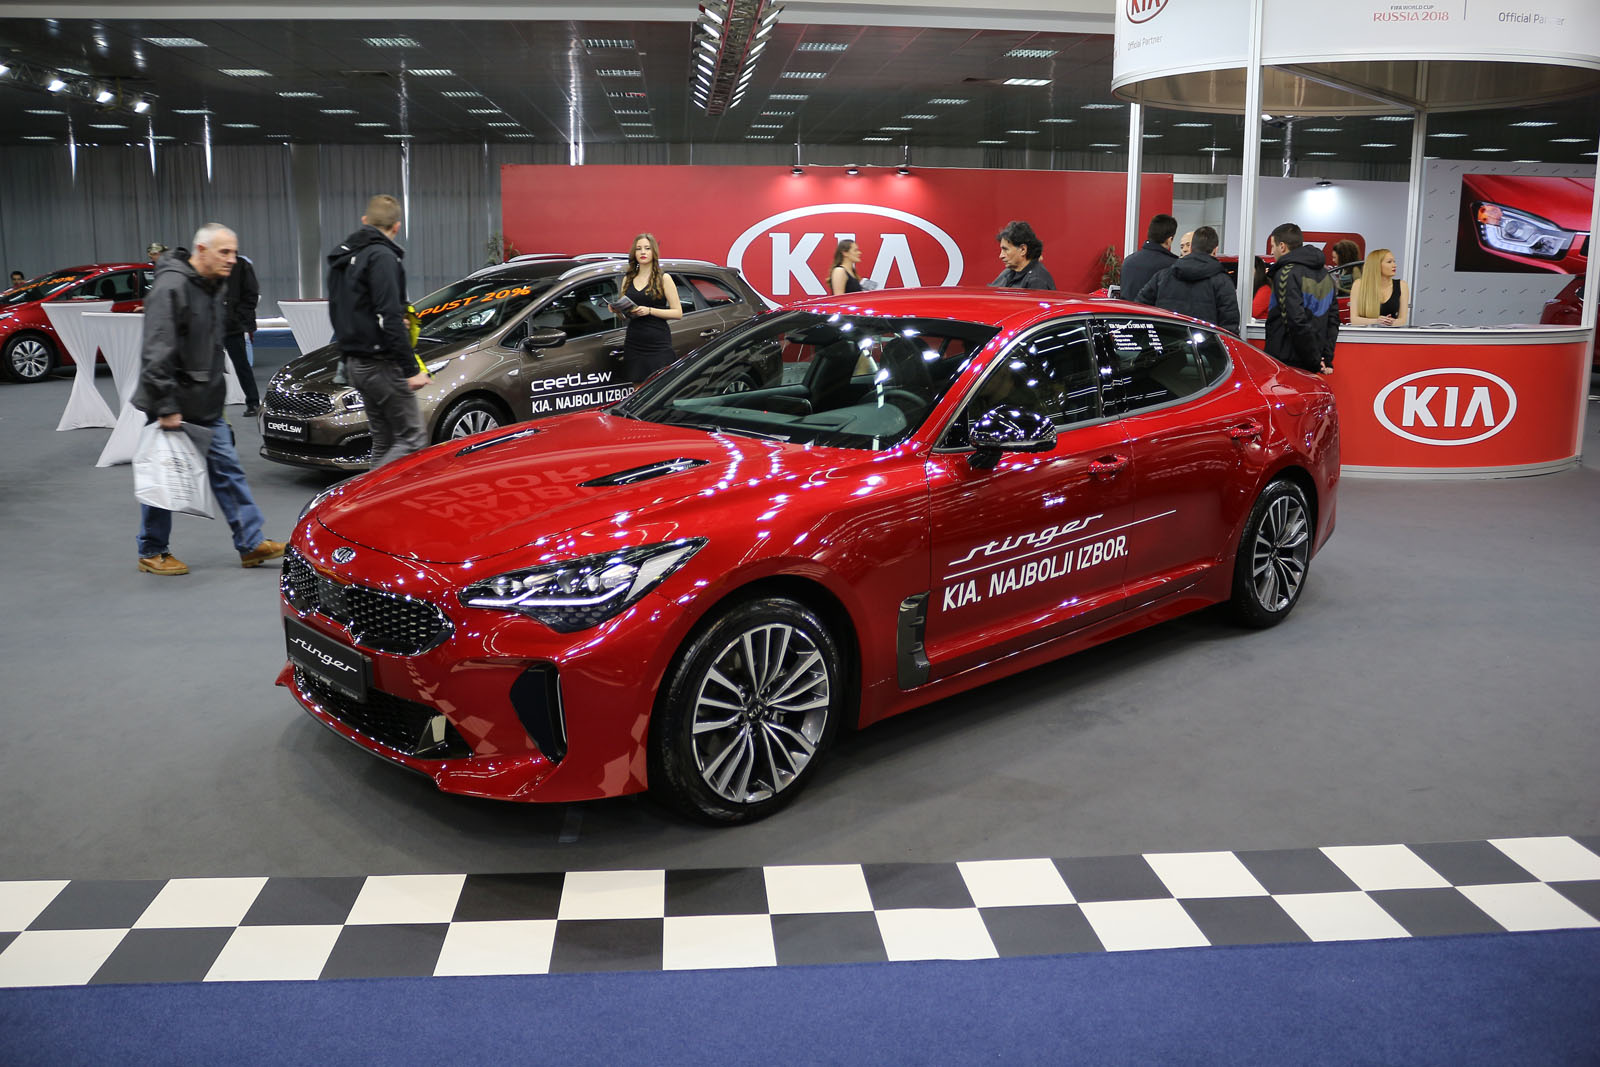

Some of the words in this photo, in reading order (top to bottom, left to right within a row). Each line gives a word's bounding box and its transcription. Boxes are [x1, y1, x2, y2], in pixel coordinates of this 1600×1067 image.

[1373, 12, 1419, 22] RUSSIA
[1422, 11, 1449, 21] 2018
[1498, 12, 1531, 23] Official
[768, 232, 922, 296] KA
[416, 295, 479, 318] PUST
[481, 286, 532, 302] 20%
[532, 400, 552, 413] KIA.
[555, 391, 603, 410] NAJBOLJI
[1402, 386, 1495, 427] KIA
[948, 514, 1104, 566] stinger
[942, 579, 981, 612] KIA.
[988, 550, 1074, 598] NAJBOLJI
[1076, 535, 1129, 571] IZBOR.
[289, 638, 358, 673] stinger
